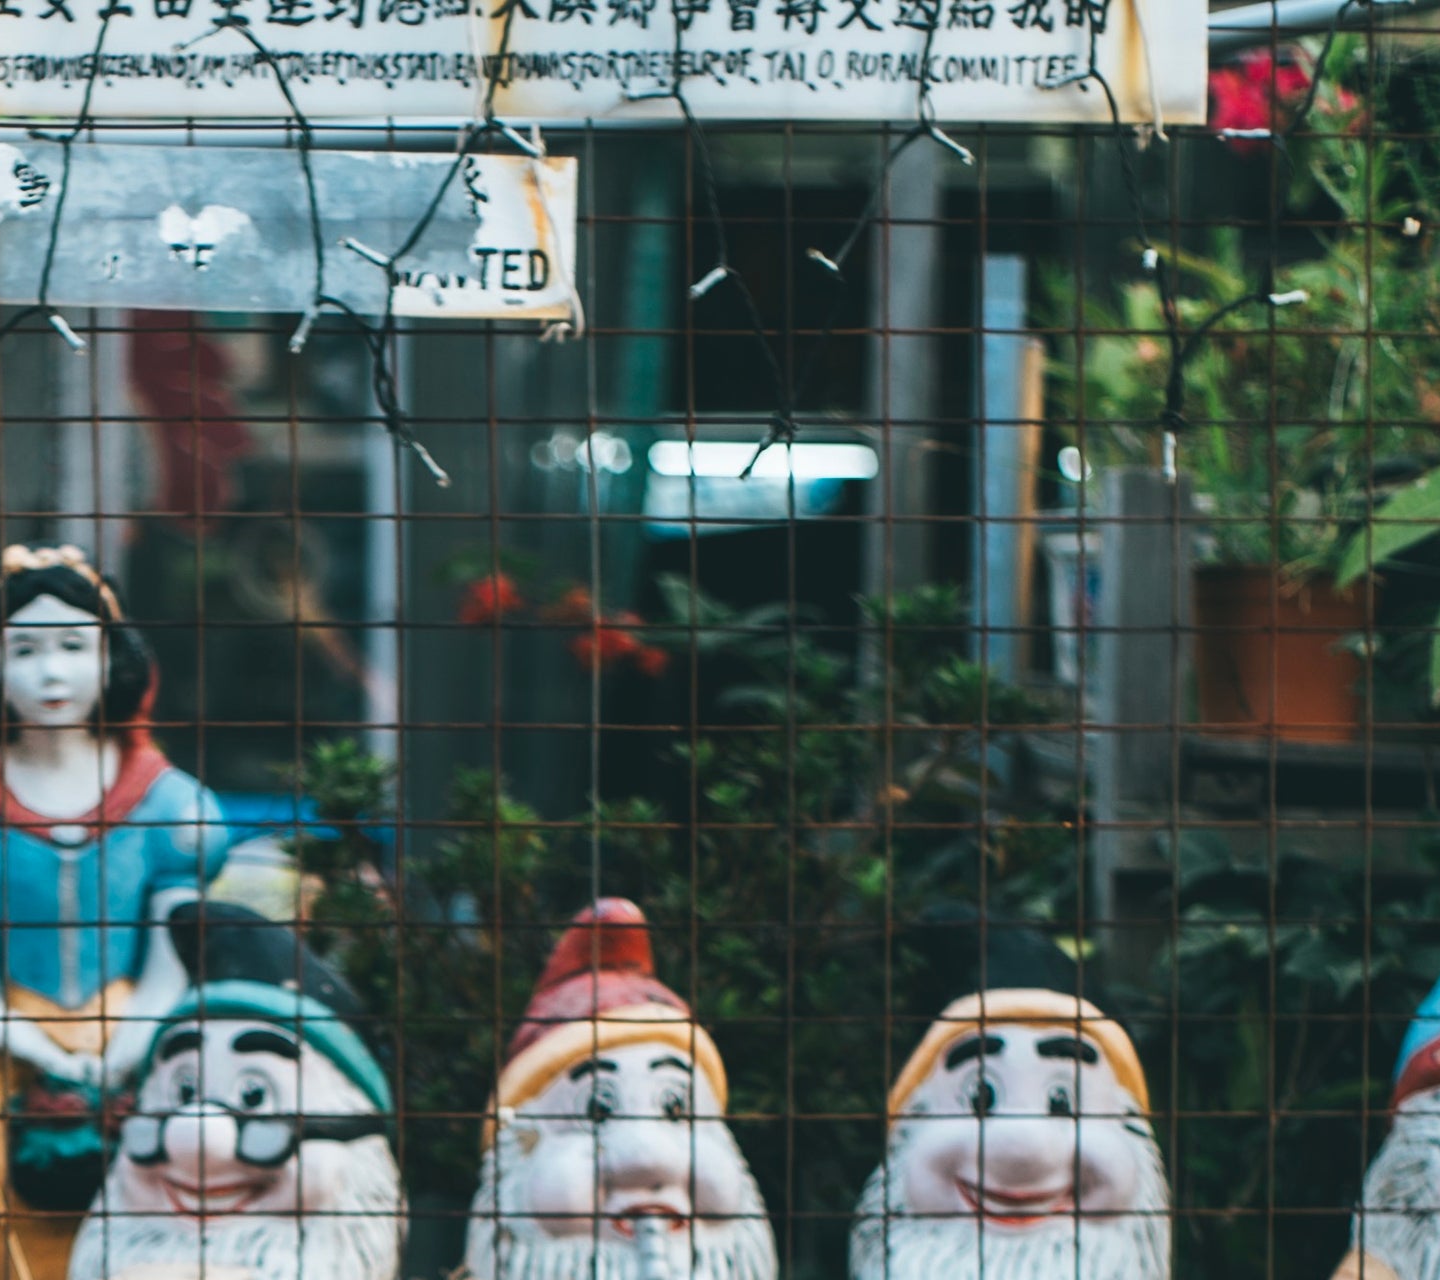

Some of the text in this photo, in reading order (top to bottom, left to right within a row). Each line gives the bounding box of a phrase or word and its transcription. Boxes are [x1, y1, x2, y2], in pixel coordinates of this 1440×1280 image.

[762, 50, 805, 79] TAI
[816, 49, 835, 80] O
[846, 51, 923, 82] RURAL
